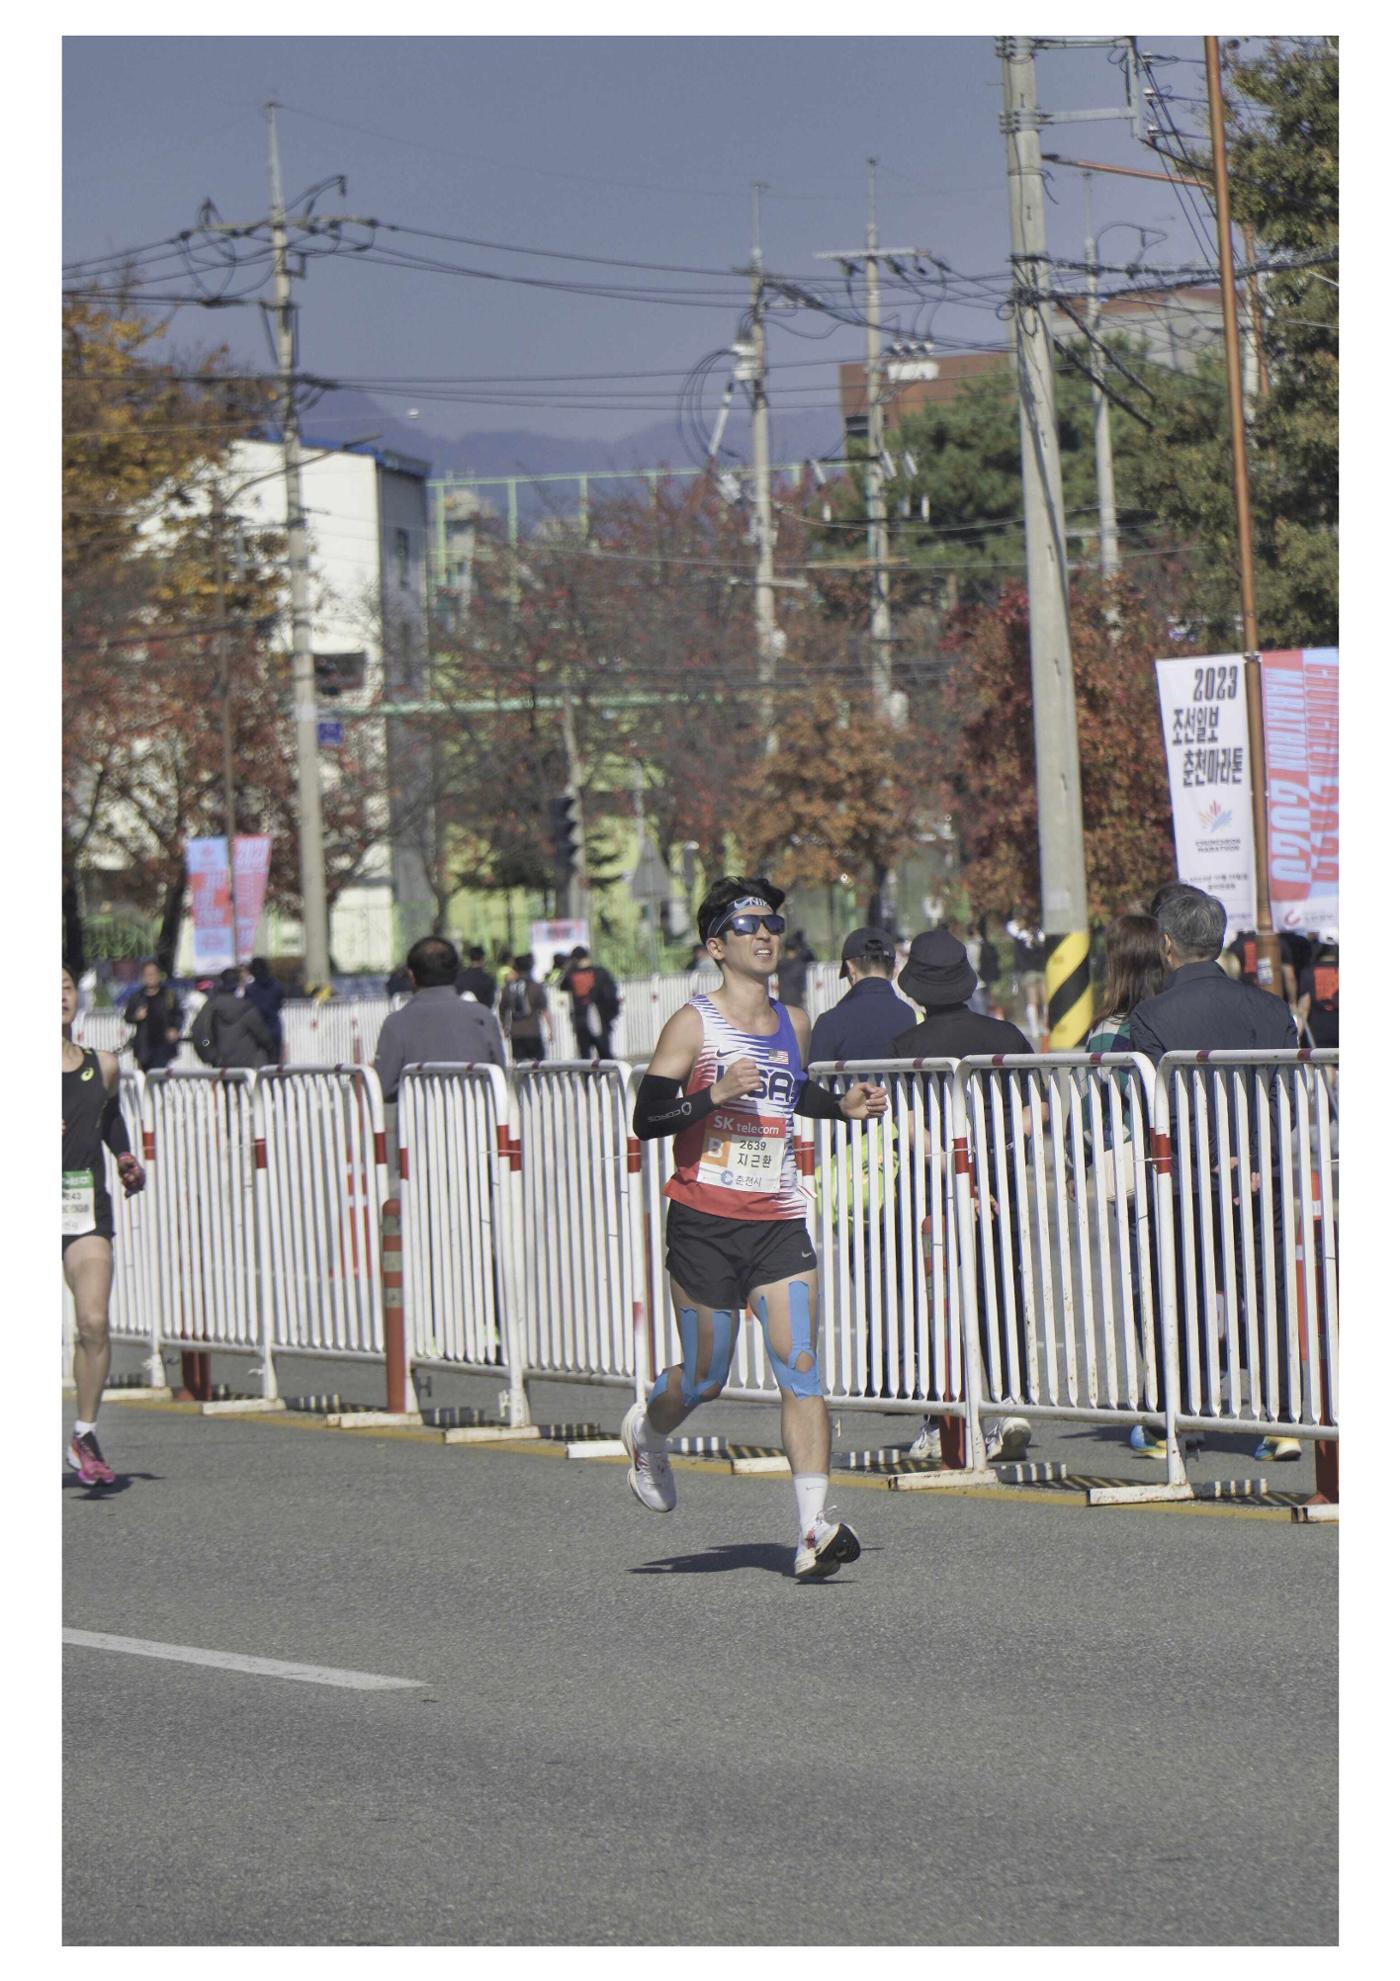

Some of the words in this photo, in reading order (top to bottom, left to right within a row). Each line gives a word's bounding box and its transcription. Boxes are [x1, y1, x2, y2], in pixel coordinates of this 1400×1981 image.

[1193, 665, 1239, 701] 2023
[1172, 705, 1220, 746] 조선일보
[1264, 667, 1307, 772] MARATHON
[1183, 747, 1243, 789] 춘천마라톤
[716, 1062, 795, 1104] SA
[713, 1114, 736, 1131] SK
[736, 1122, 780, 1135] telecom
[737, 1153, 772, 1169] 지근환
[739, 1139, 767, 1151] 2639
